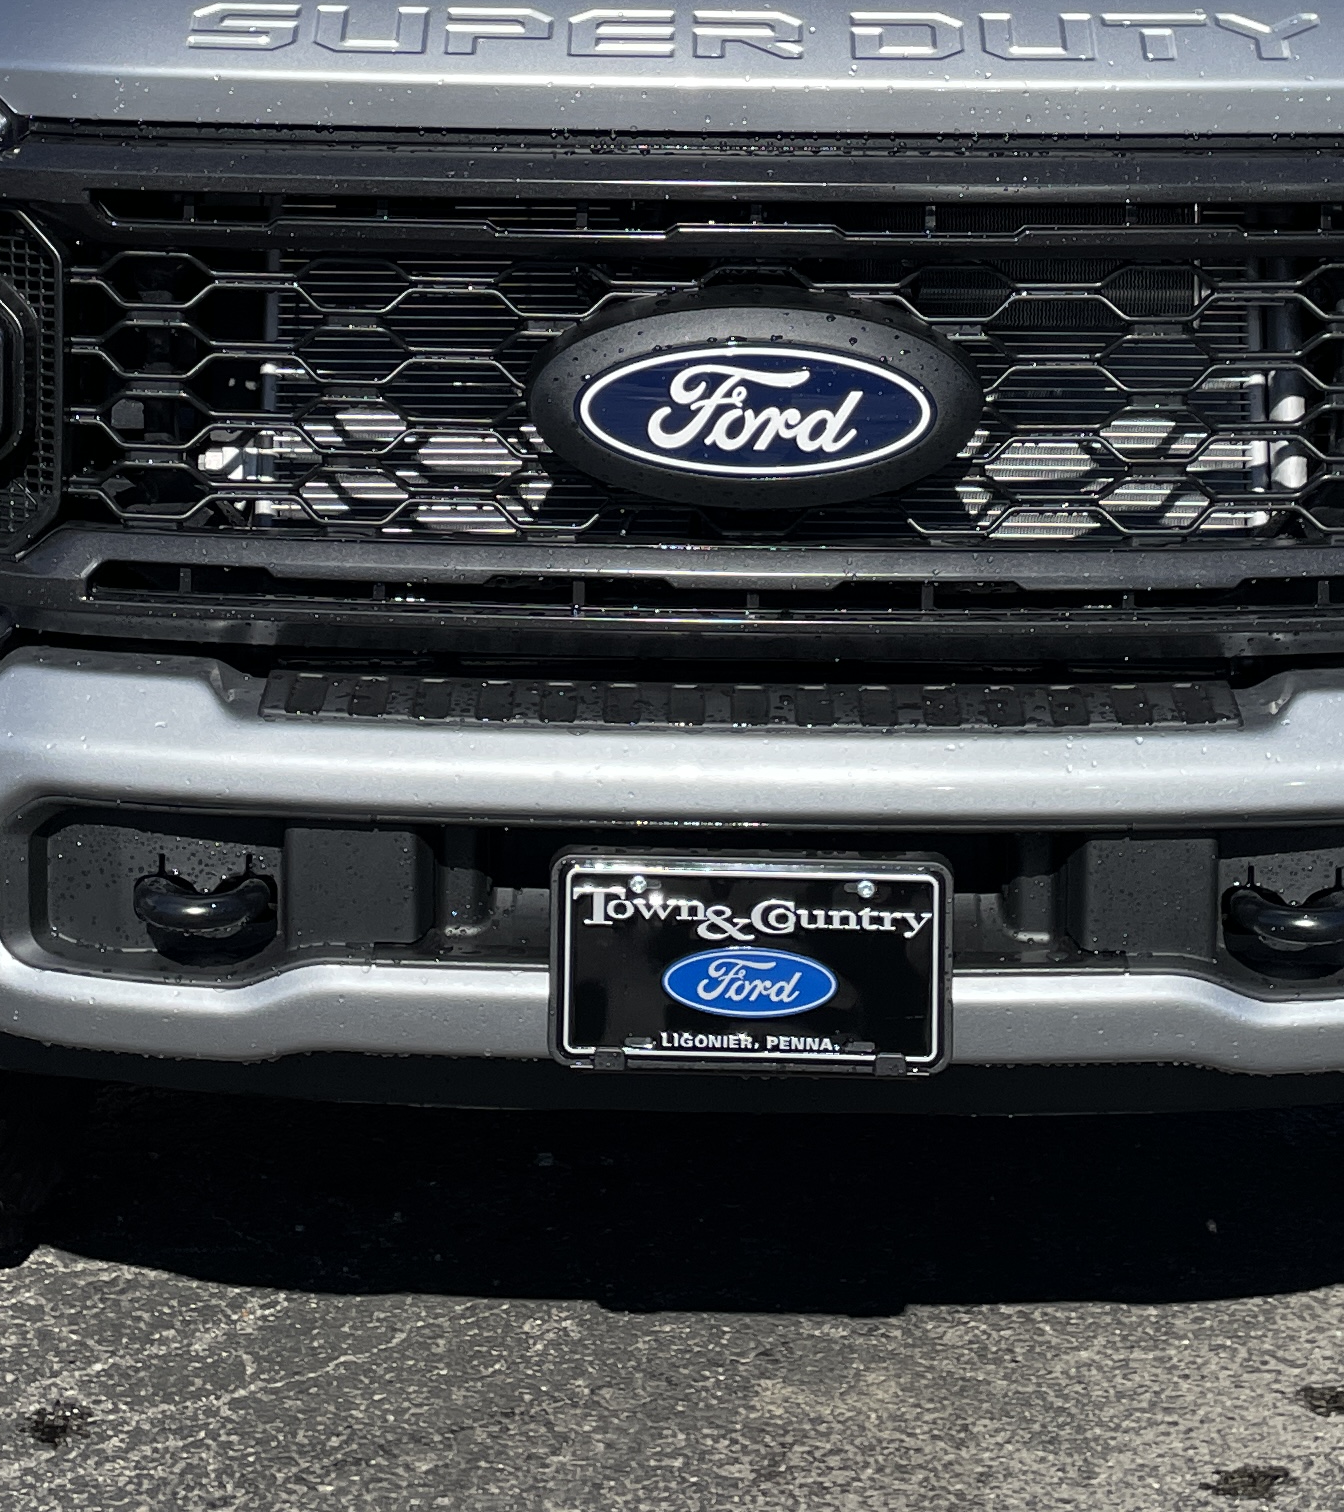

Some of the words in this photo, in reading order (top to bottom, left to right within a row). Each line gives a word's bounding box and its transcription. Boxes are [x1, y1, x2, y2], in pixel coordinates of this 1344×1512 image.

[187, 2, 804, 62] SUPER
[849, 11, 1320, 62] DUTY
[646, 363, 864, 453] Ford
[572, 886, 707, 926] Town
[696, 903, 755, 941] &
[750, 899, 932, 939] Country
[696, 957, 801, 1003] Ford
